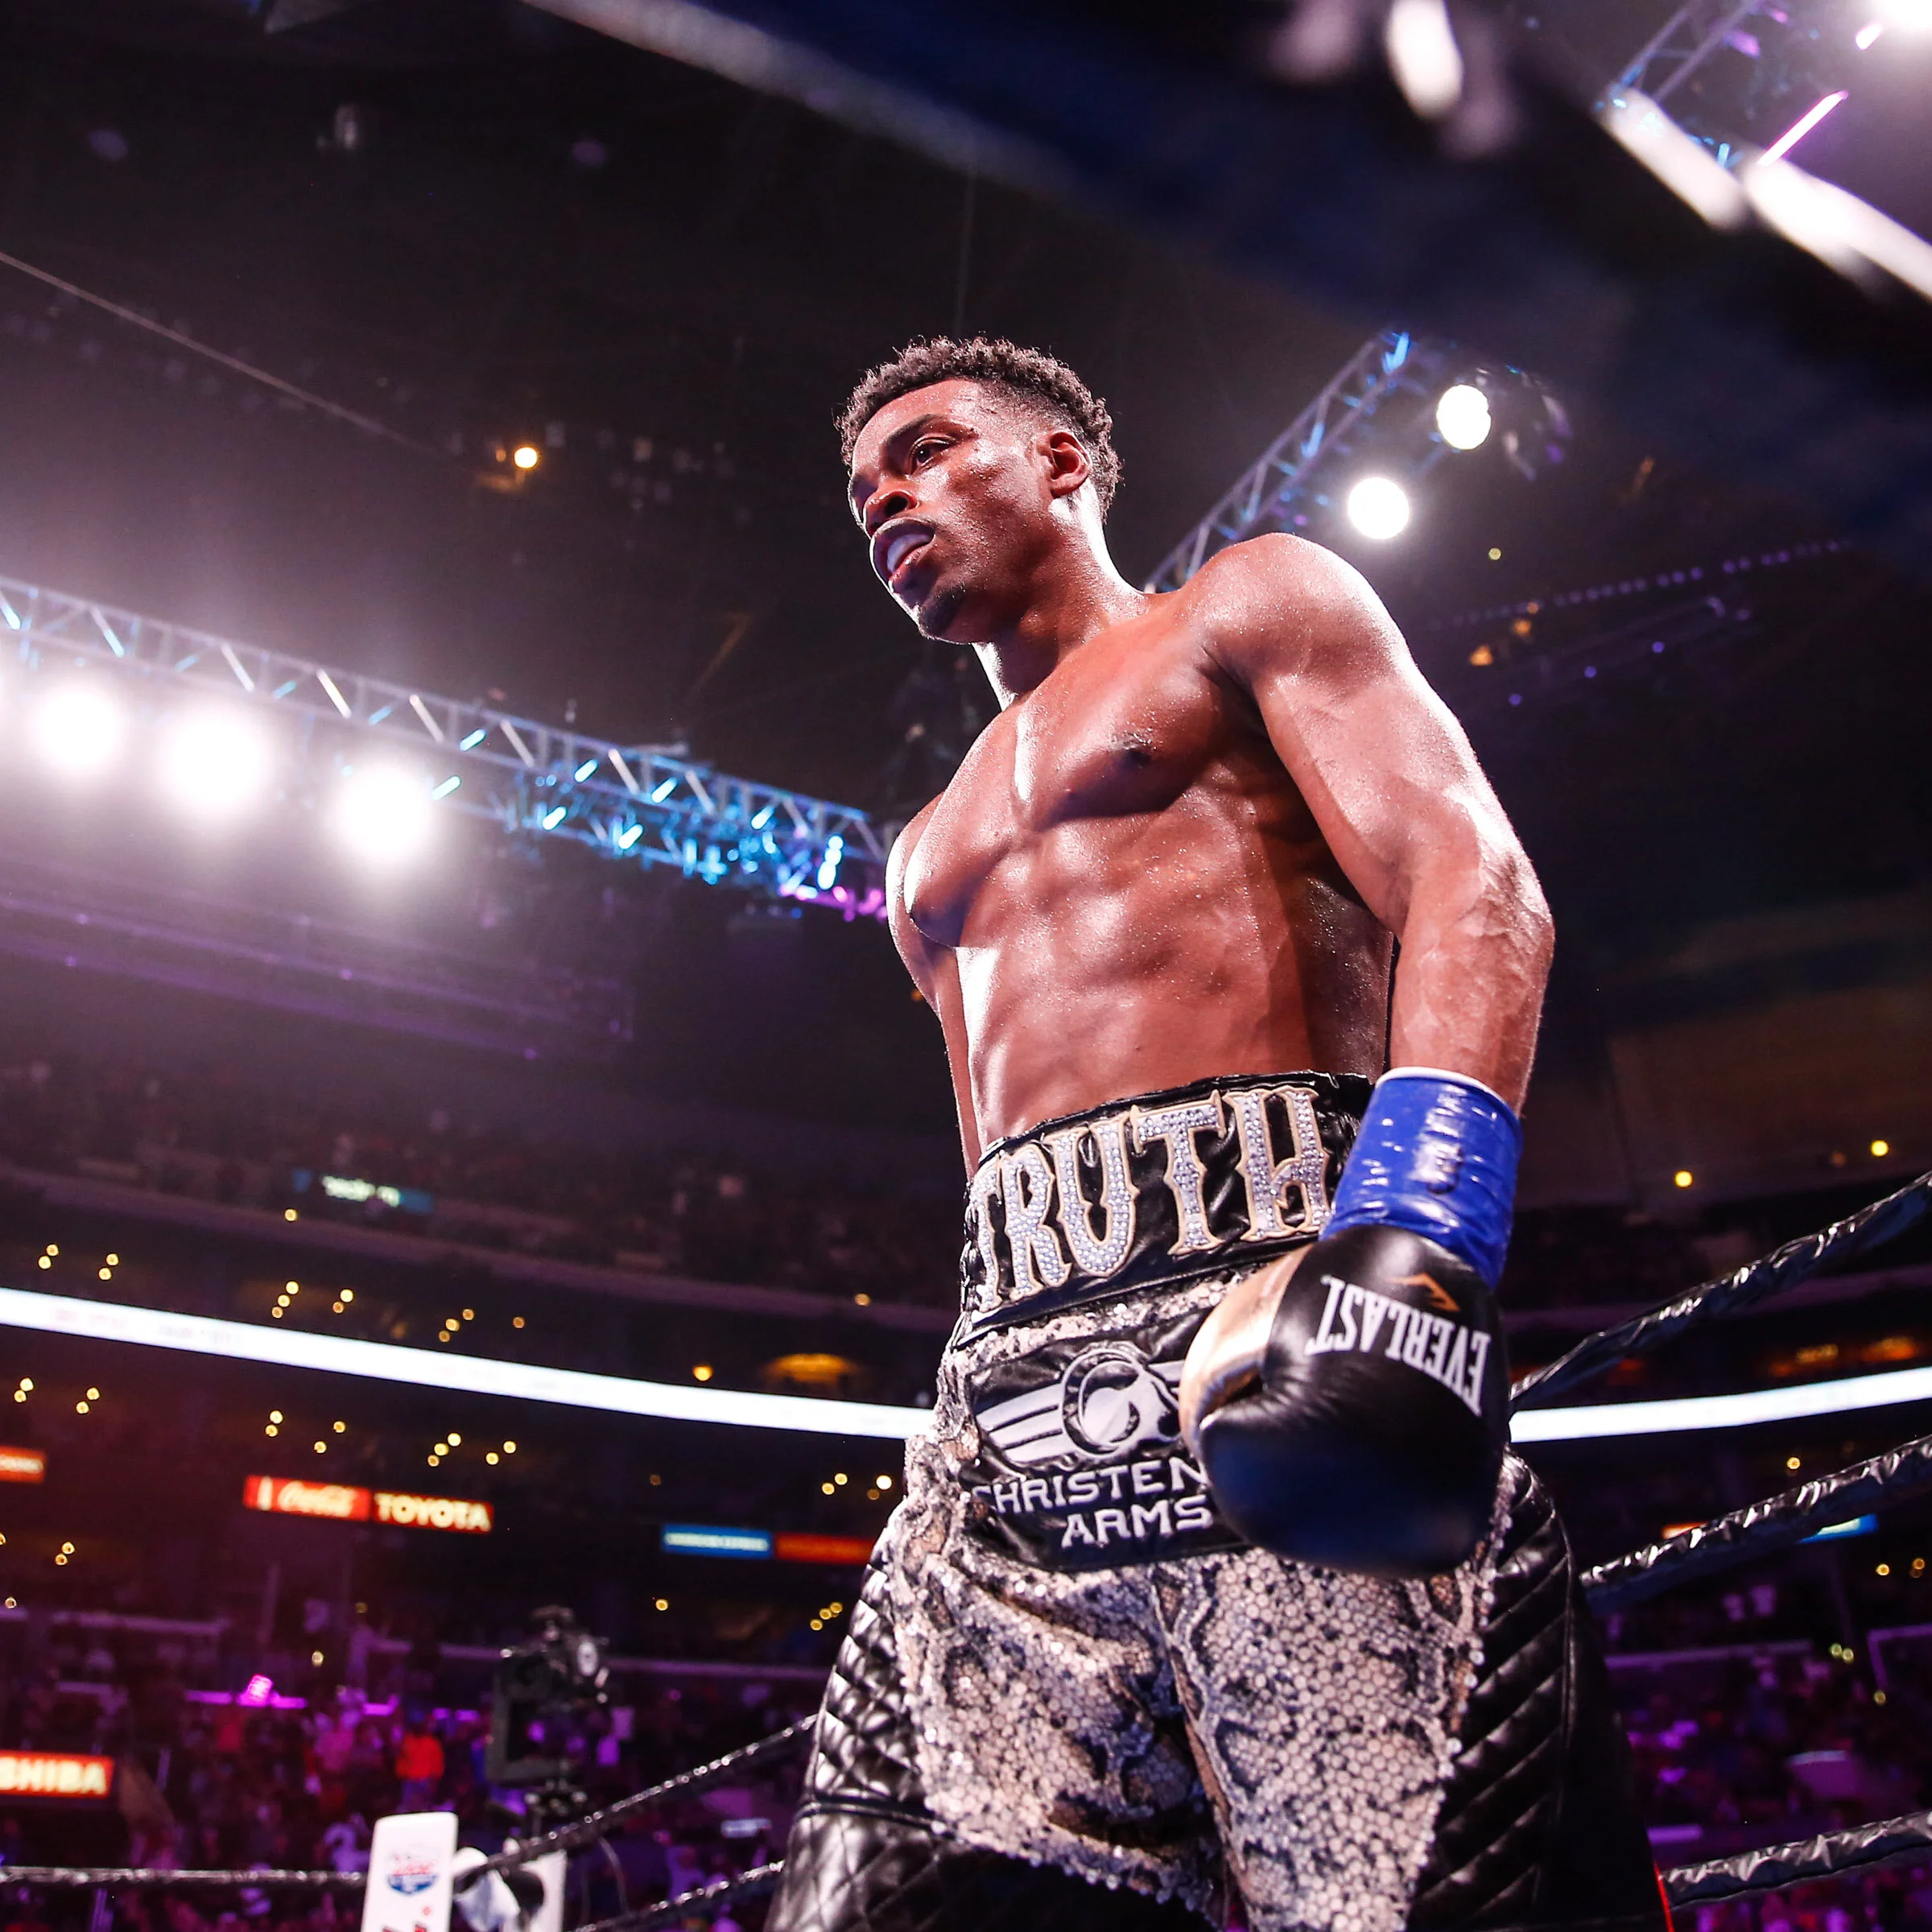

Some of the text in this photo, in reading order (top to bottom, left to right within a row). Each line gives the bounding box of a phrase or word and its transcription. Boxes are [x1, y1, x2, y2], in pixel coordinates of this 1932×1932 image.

[968, 1085, 1334, 1314] TRUTH
[1303, 1274, 1492, 1418] EVERLAST
[374, 1492, 491, 1532] TOYOTA
[1061, 1494, 1213, 1548] ARMS
